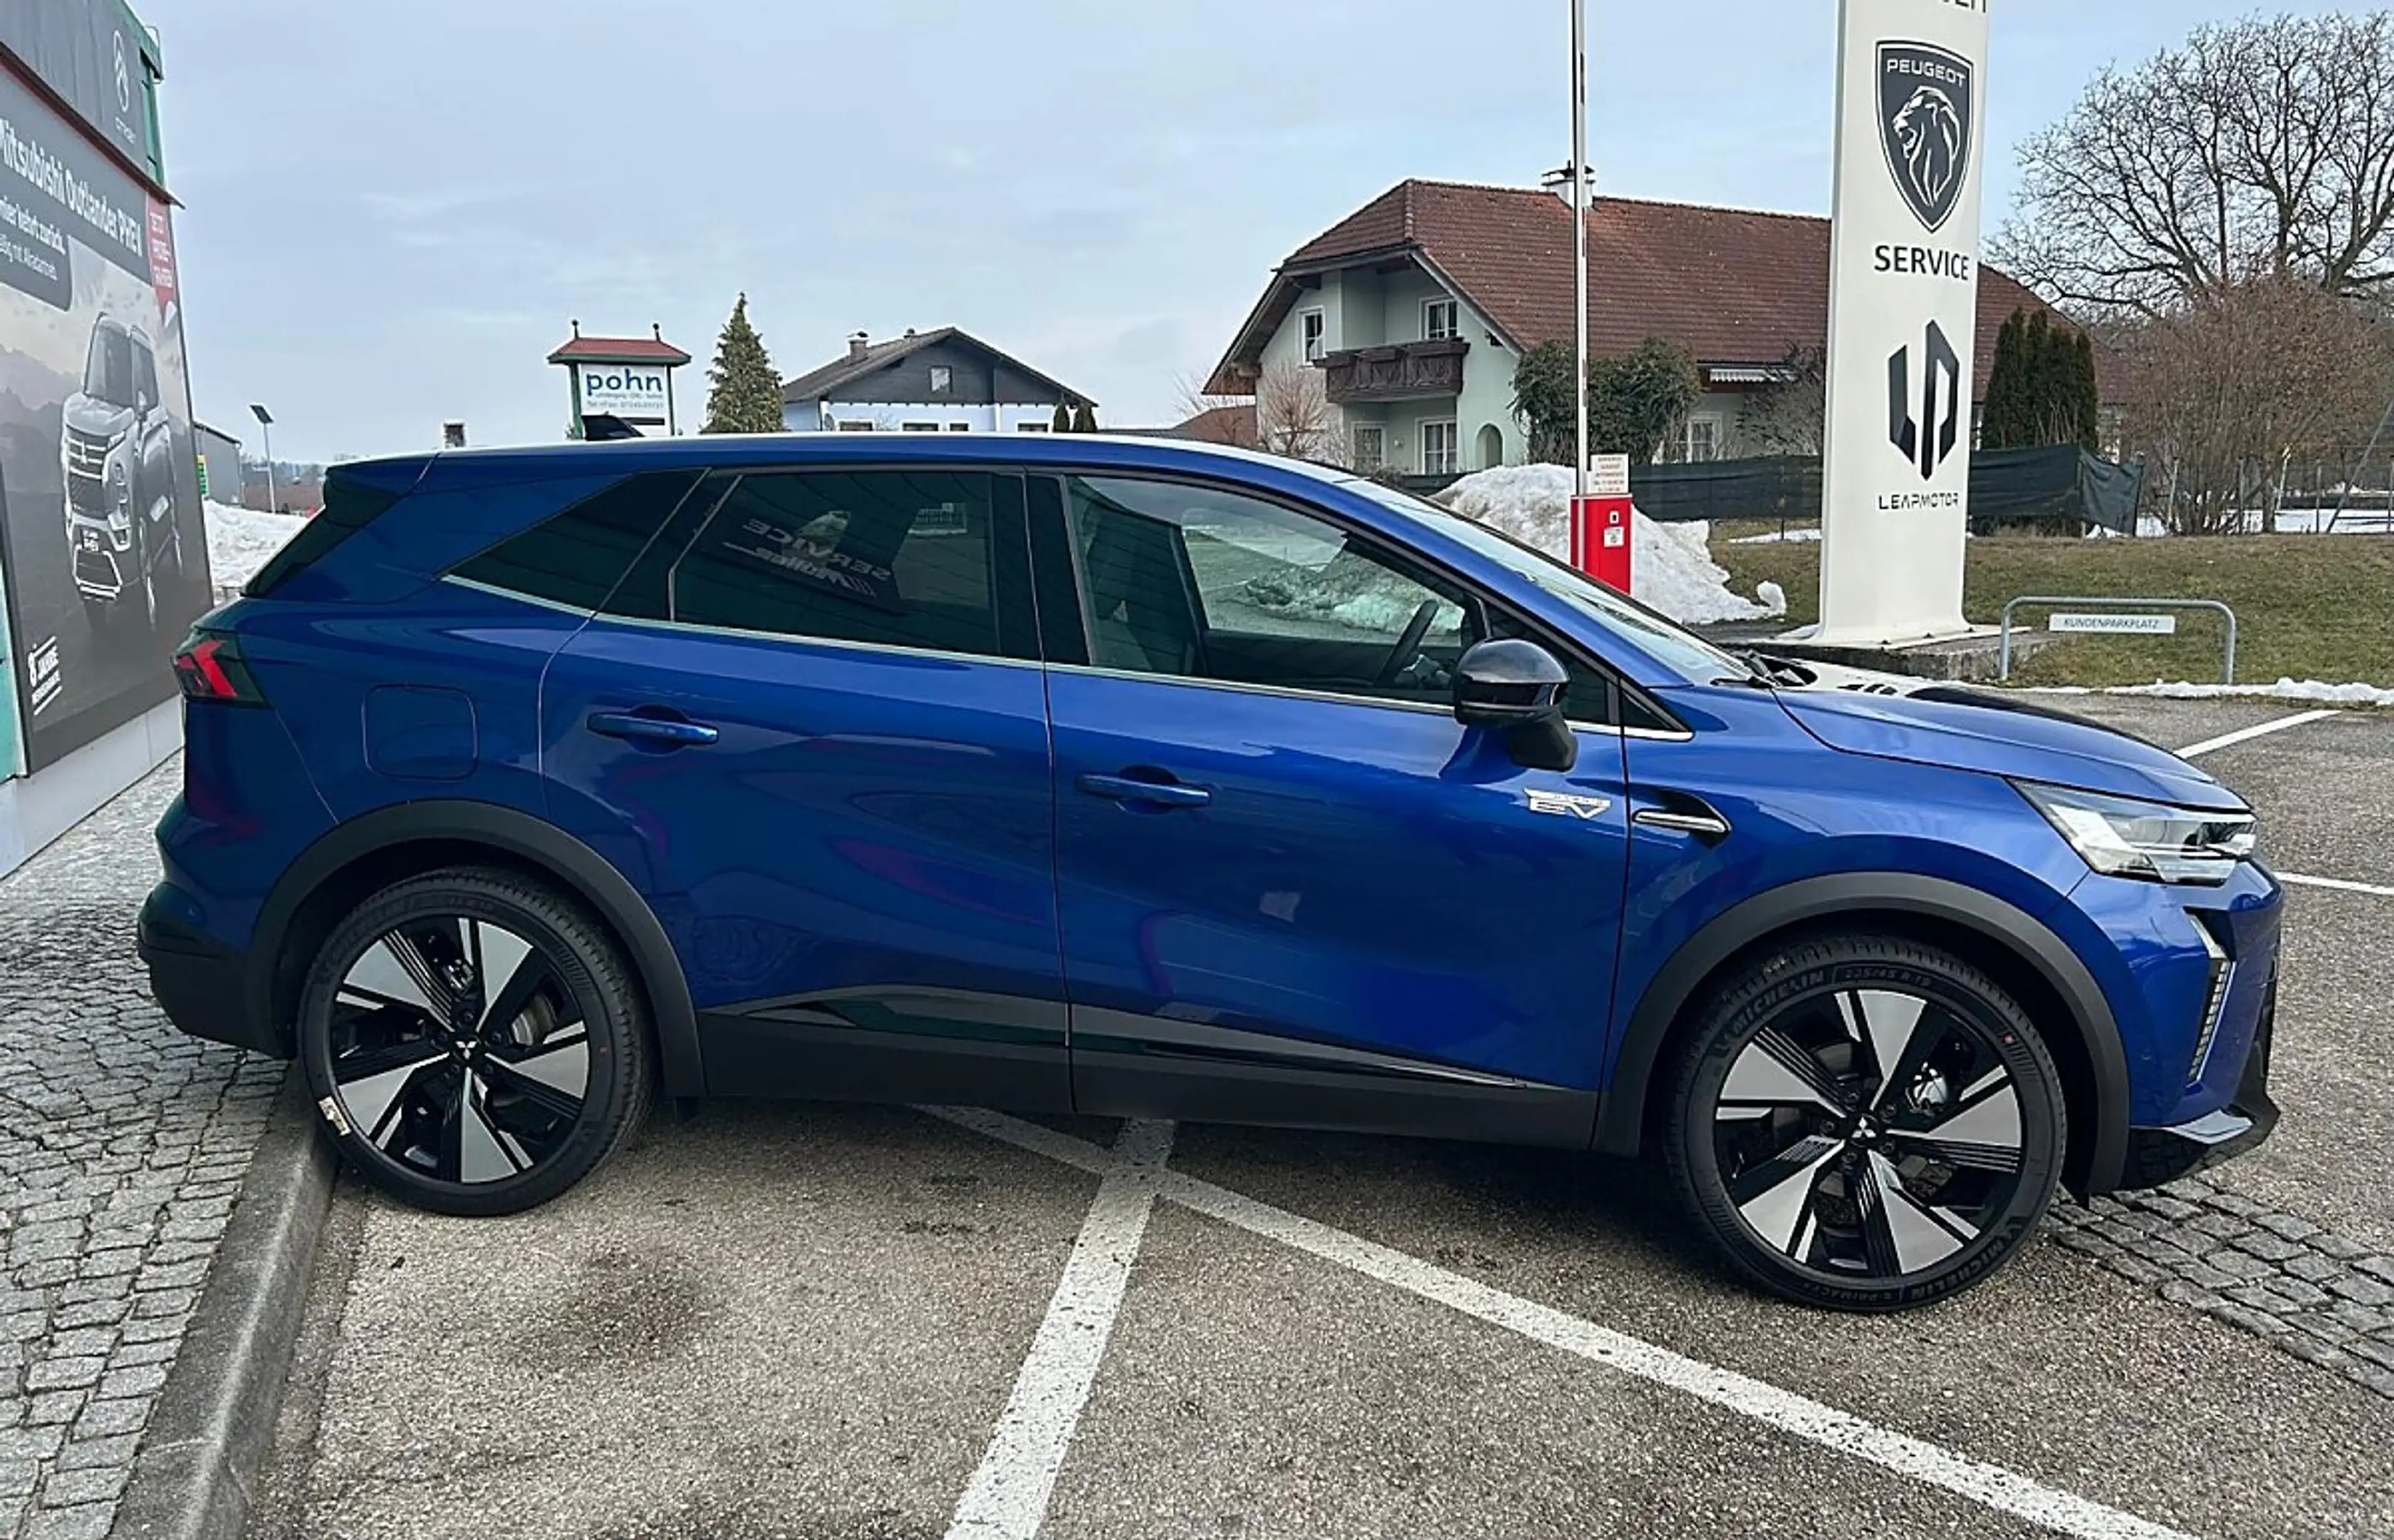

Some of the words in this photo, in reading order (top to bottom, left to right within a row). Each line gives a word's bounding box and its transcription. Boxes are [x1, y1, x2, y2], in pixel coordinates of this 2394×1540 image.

[1887, 59, 1966, 87] PEUGEOT
[1874, 245, 1969, 281] SERVICE
[586, 368, 663, 396] pohn
[1878, 492, 1958, 510] LEAPMOTOR
[2064, 618, 2160, 630] KUNDENPARKPLATZ
[1733, 970, 1824, 1034] MICHELIN
[1910, 1239, 2004, 1299] MICHELIN
